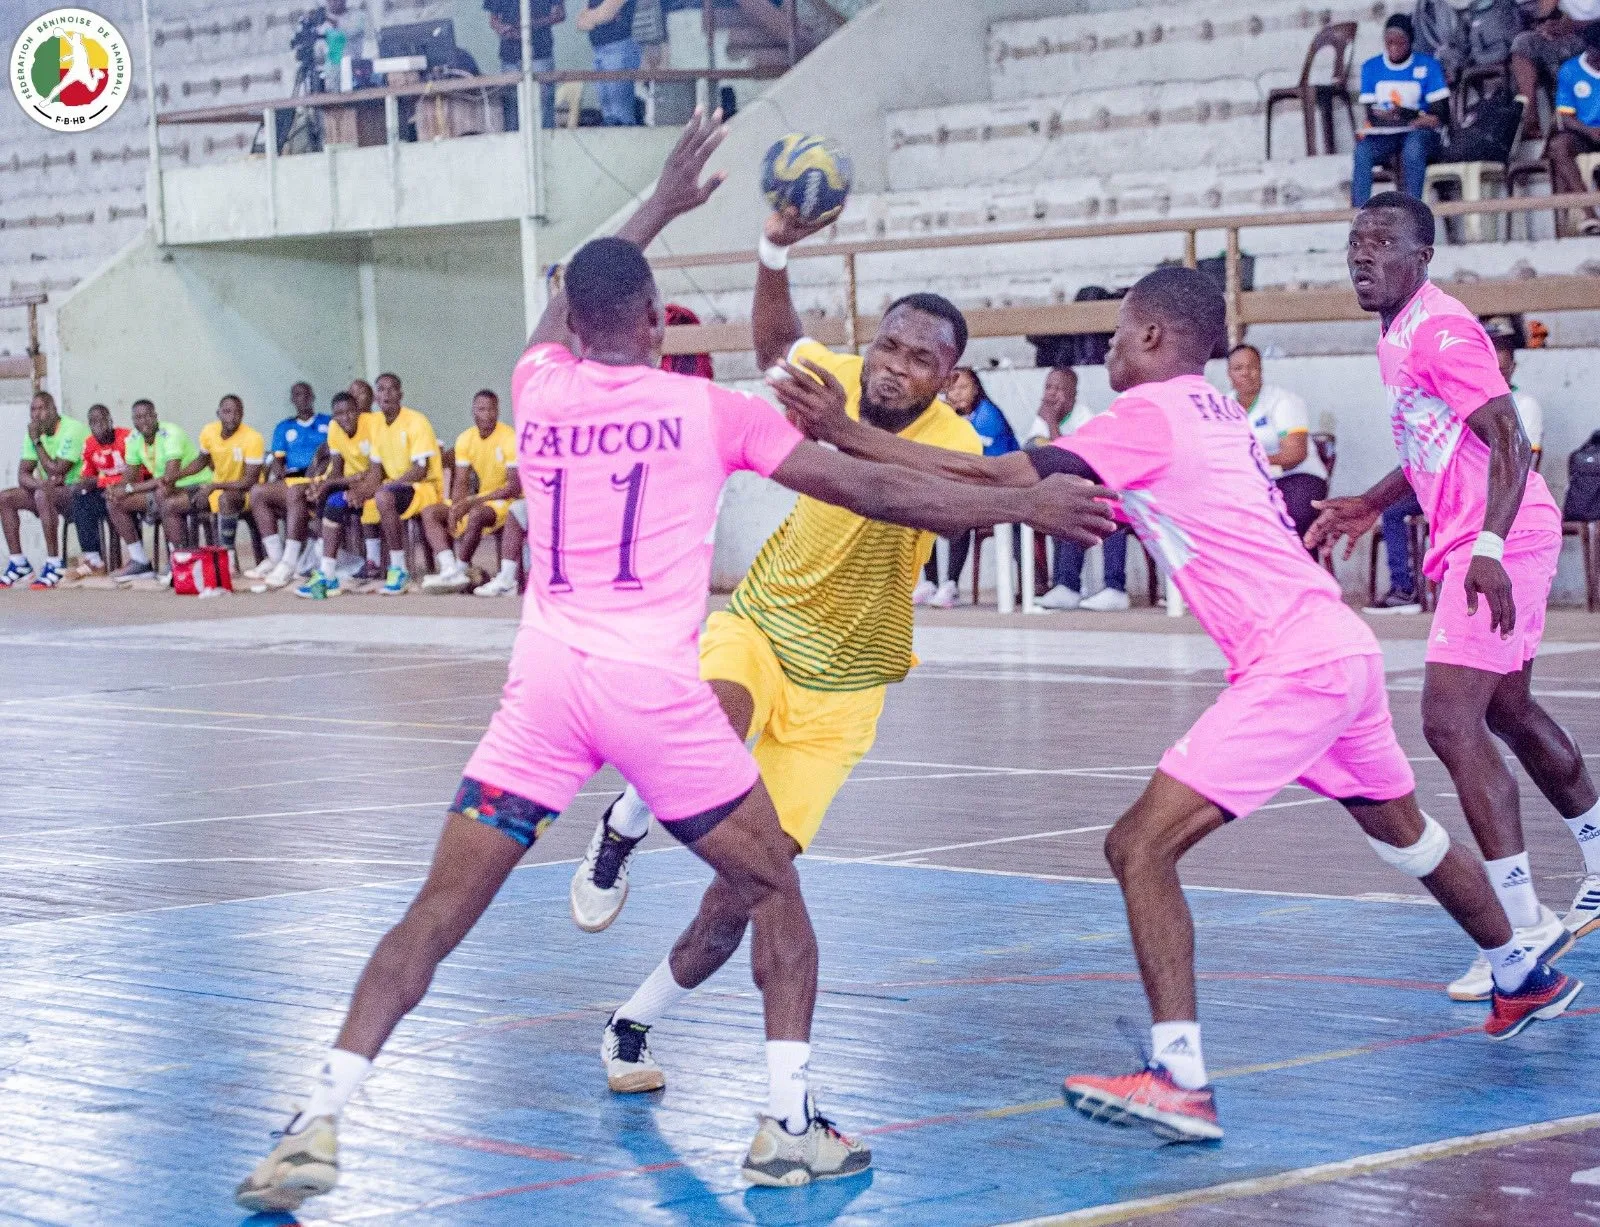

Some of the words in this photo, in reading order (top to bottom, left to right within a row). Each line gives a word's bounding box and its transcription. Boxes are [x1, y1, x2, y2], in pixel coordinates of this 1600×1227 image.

[1188, 393, 1247, 420] FAU
[520, 417, 682, 457] FAUCON
[540, 462, 650, 593] 11
